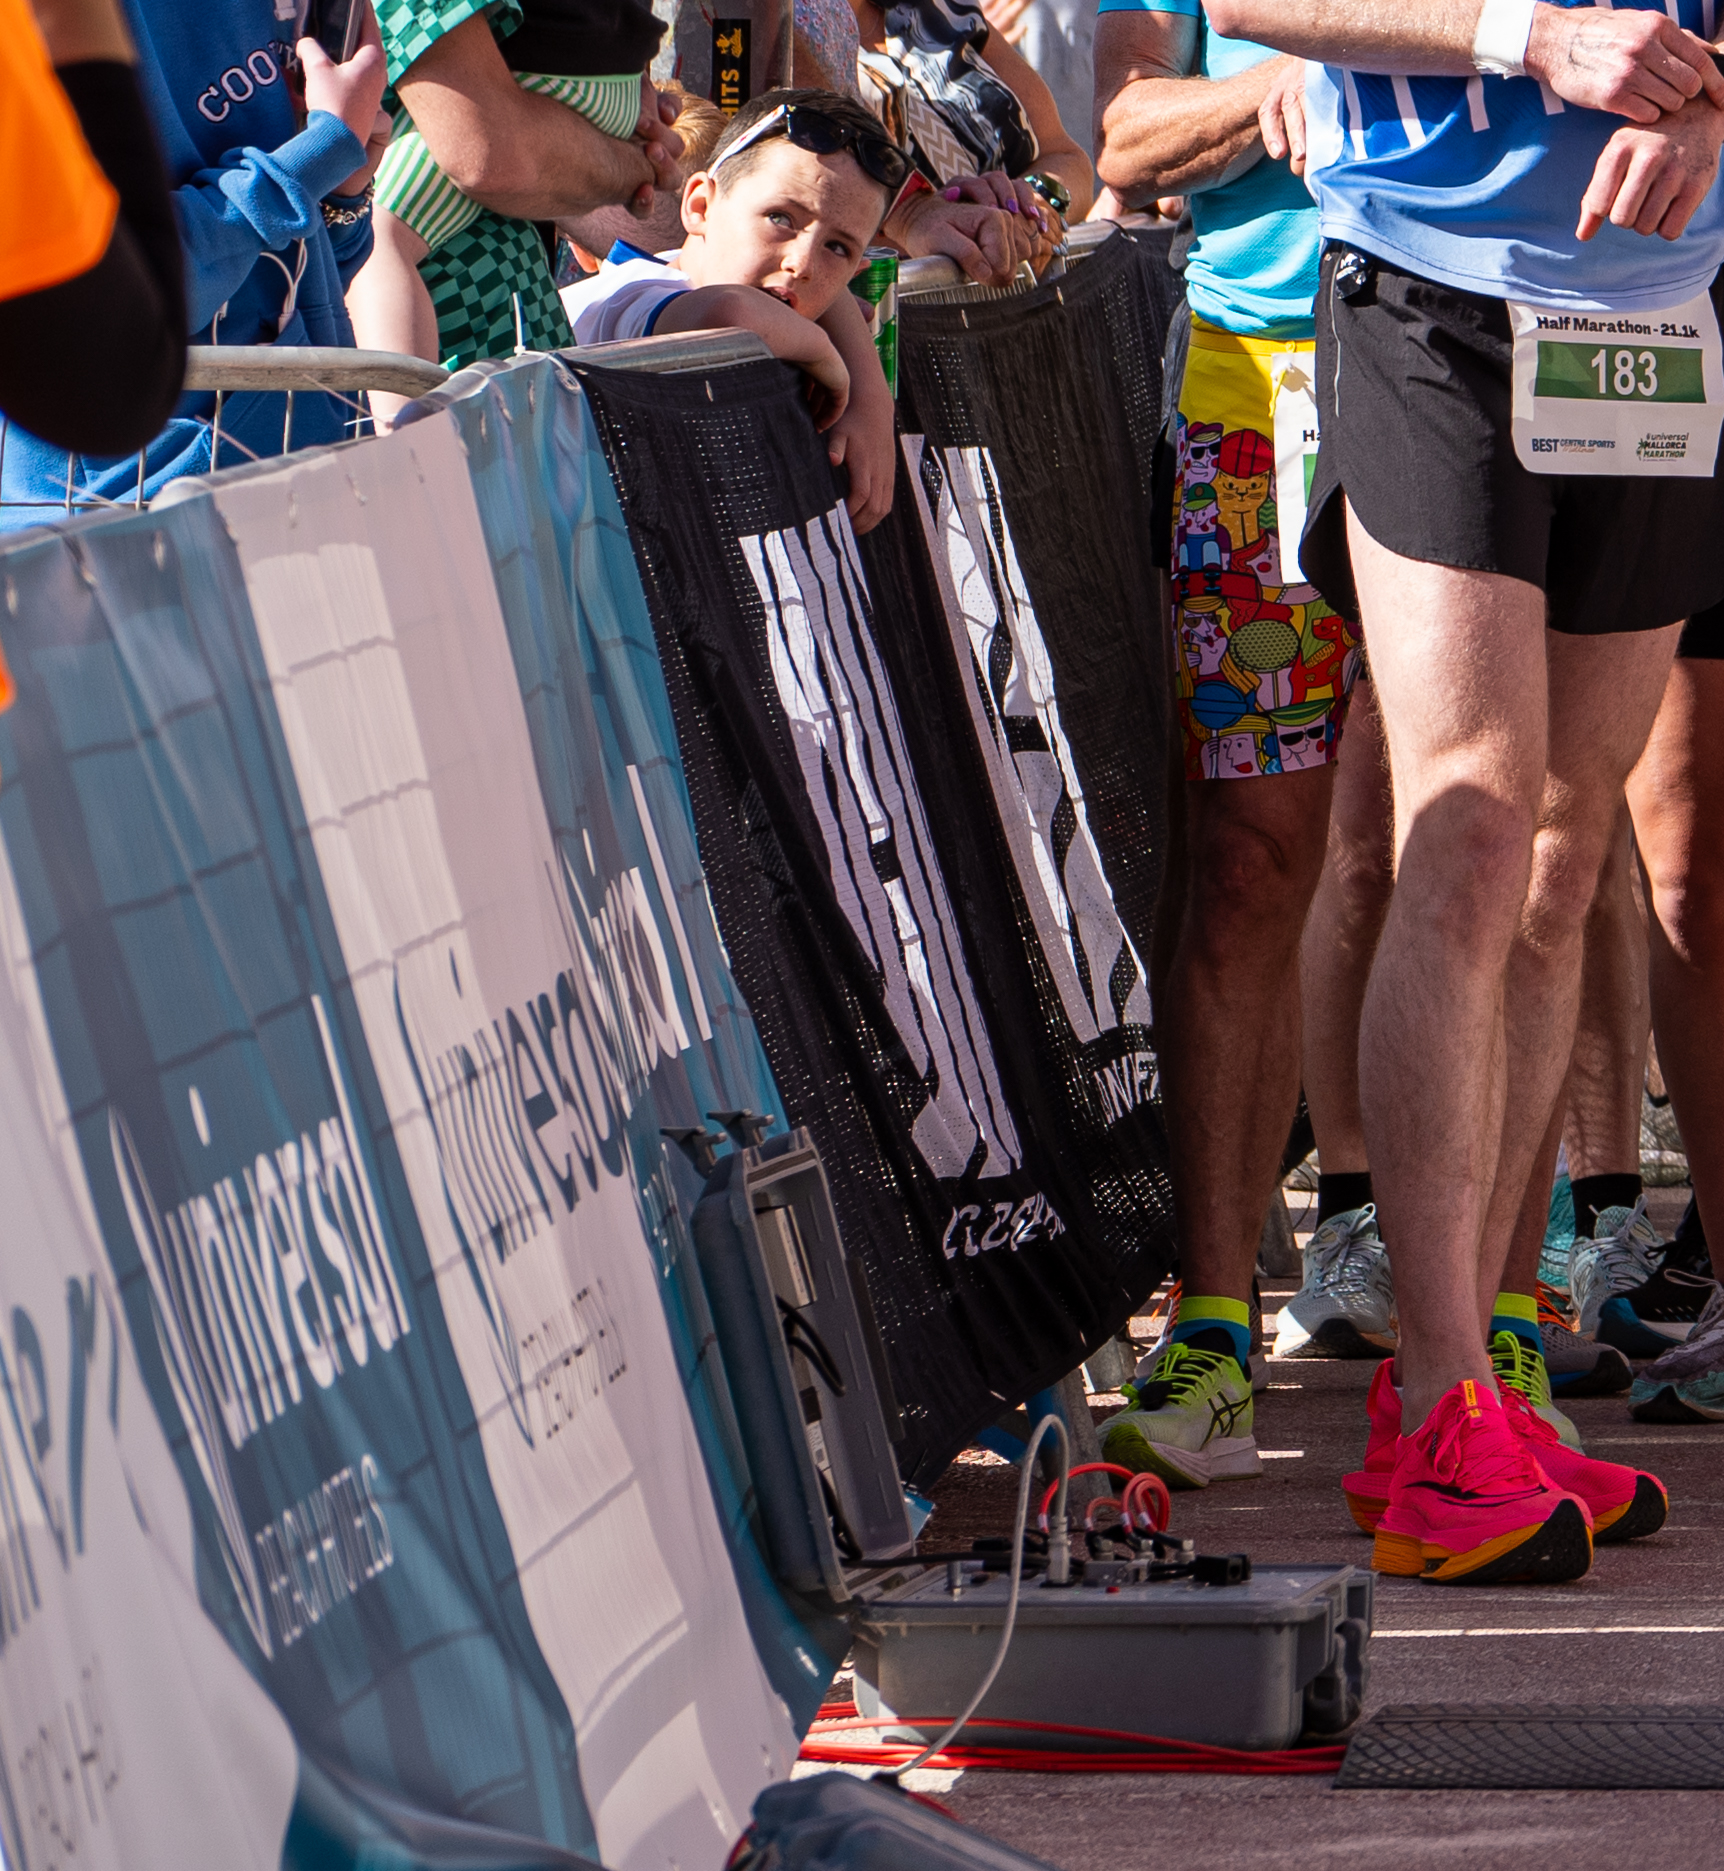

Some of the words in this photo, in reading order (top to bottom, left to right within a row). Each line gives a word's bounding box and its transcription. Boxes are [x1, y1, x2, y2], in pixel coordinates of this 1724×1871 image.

[1536, 316, 1571, 331] Half
[1573, 317, 1651, 335] Marathon
[1661, 323, 1700, 339] 21.1k
[1591, 349, 1658, 397] 183
[1651, 432, 1689, 441] universal
[1532, 438, 1559, 453] BEST
[1587, 439, 1616, 449] SPORTS
[1644, 441, 1687, 450] MALLORCA
[1643, 449, 1686, 458] MARATHON
